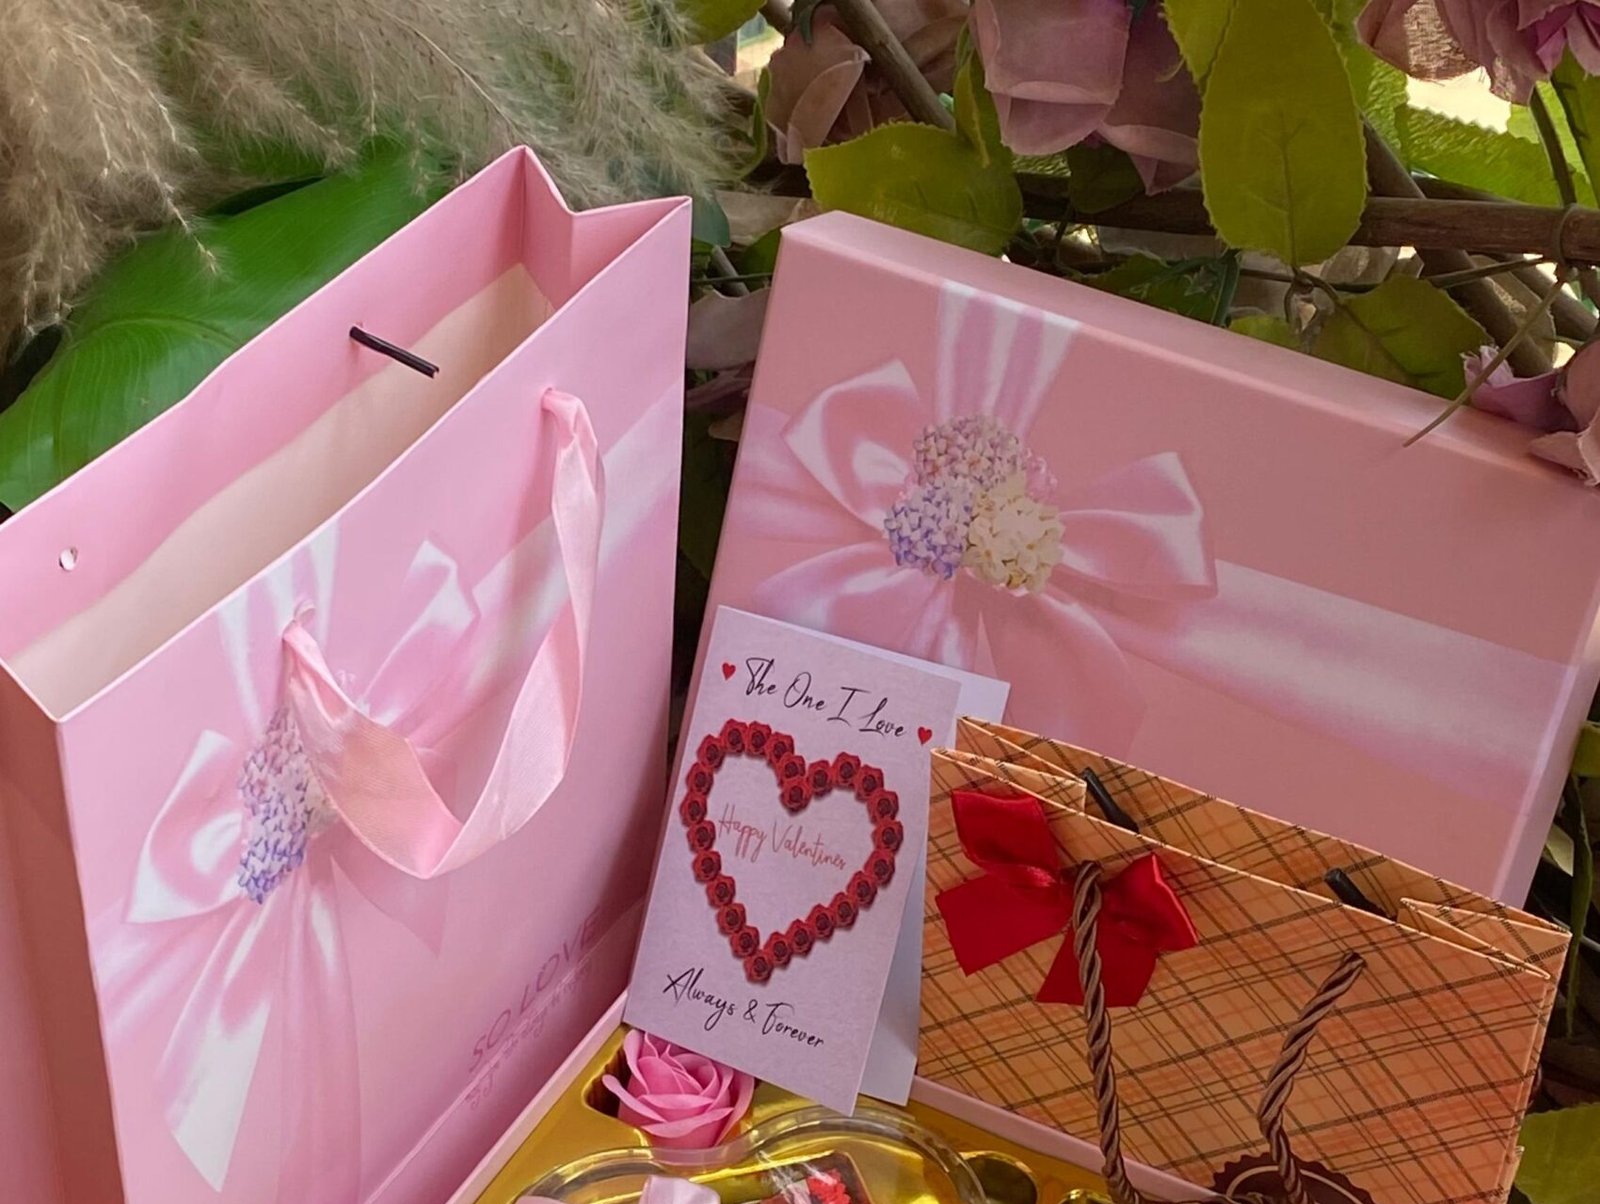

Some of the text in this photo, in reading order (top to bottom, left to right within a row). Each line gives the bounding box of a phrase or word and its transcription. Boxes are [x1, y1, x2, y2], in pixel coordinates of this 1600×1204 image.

[745, 657, 907, 737] The One I Love
[718, 802, 846, 870] Happy Valentines
[662, 967, 824, 1047] Always & Forever
